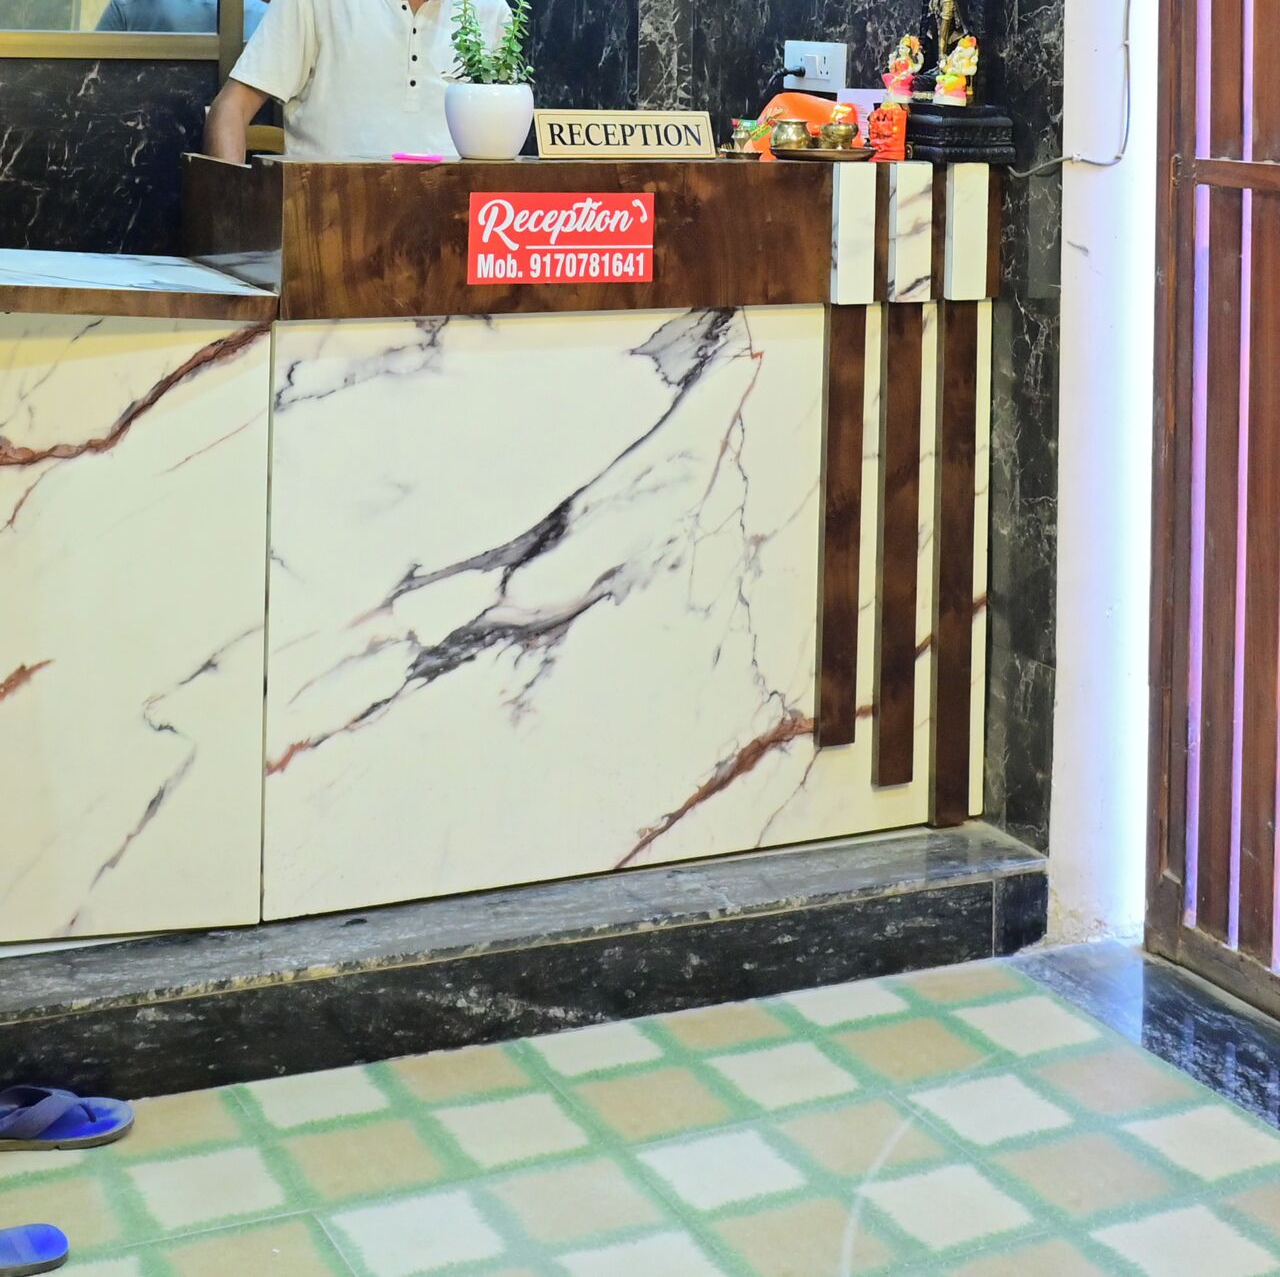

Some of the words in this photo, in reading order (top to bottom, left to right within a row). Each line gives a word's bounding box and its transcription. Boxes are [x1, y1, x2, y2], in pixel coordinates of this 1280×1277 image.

[547, 123, 703, 147] RECEPTION
[477, 197, 634, 251] Reception
[477, 253, 523, 278] Mob.
[530, 252, 645, 278] 9170781641
